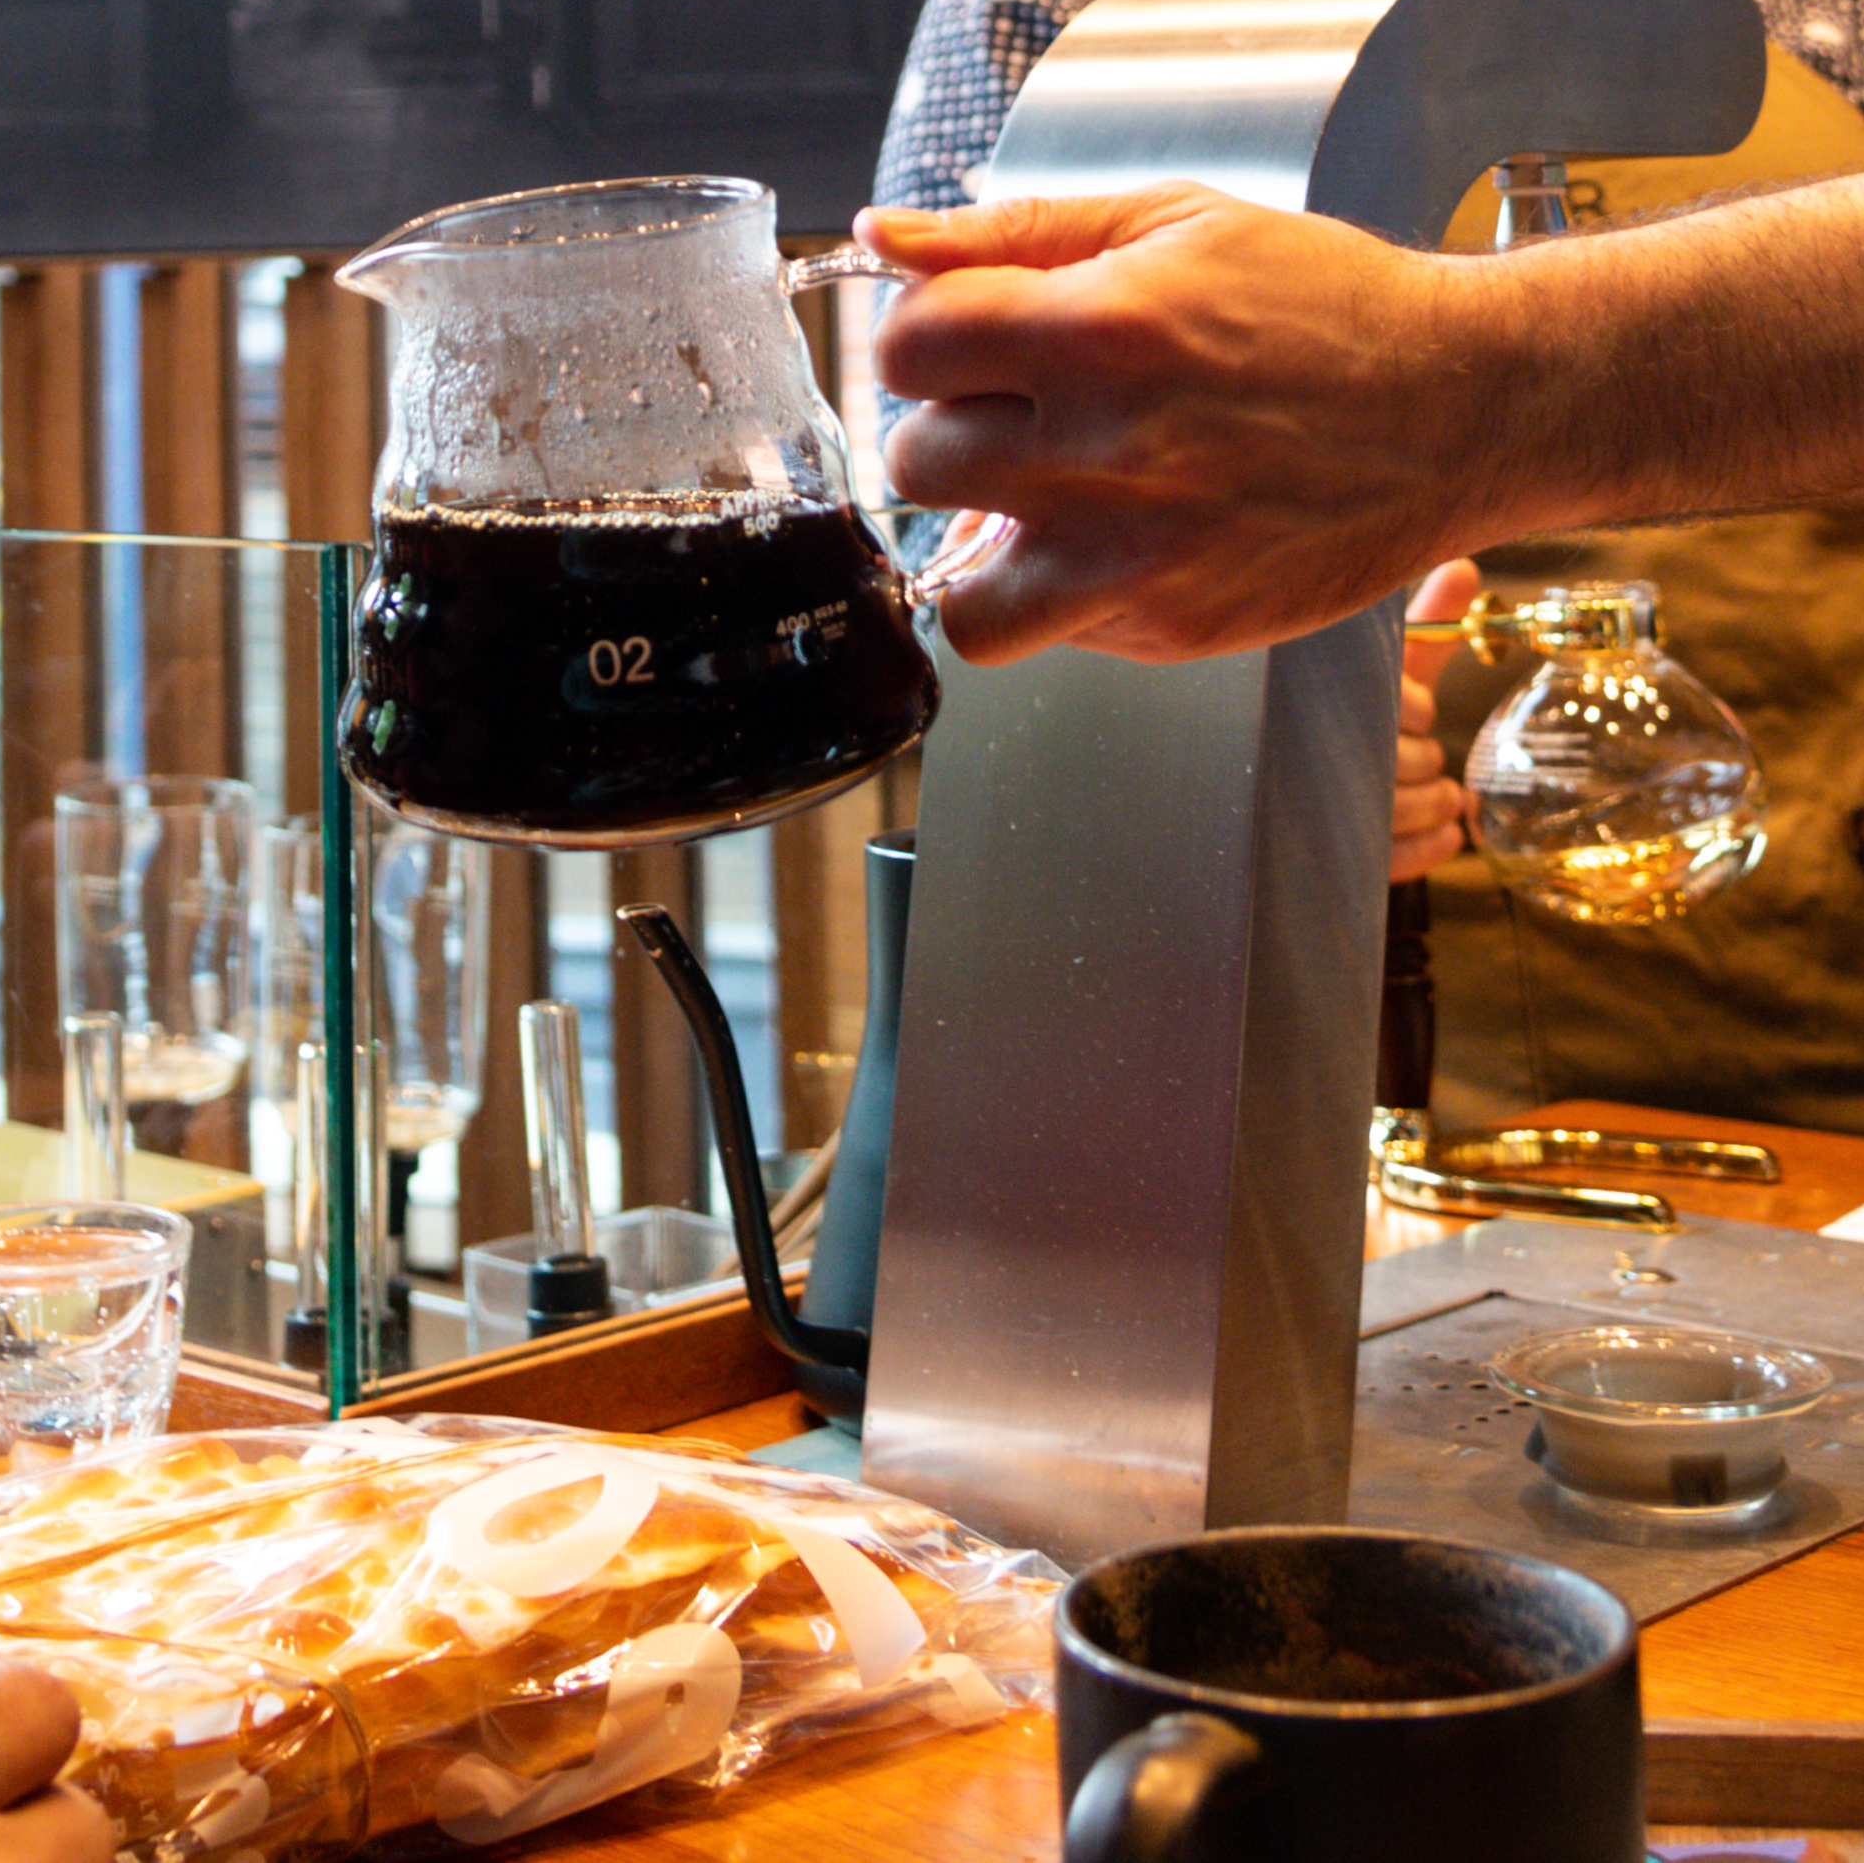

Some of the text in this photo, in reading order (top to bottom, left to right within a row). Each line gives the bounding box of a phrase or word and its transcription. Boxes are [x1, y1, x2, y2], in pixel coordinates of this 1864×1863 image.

[743, 511, 780, 538] 500
[776, 612, 810, 636] 400
[587, 635, 655, 688] 02
